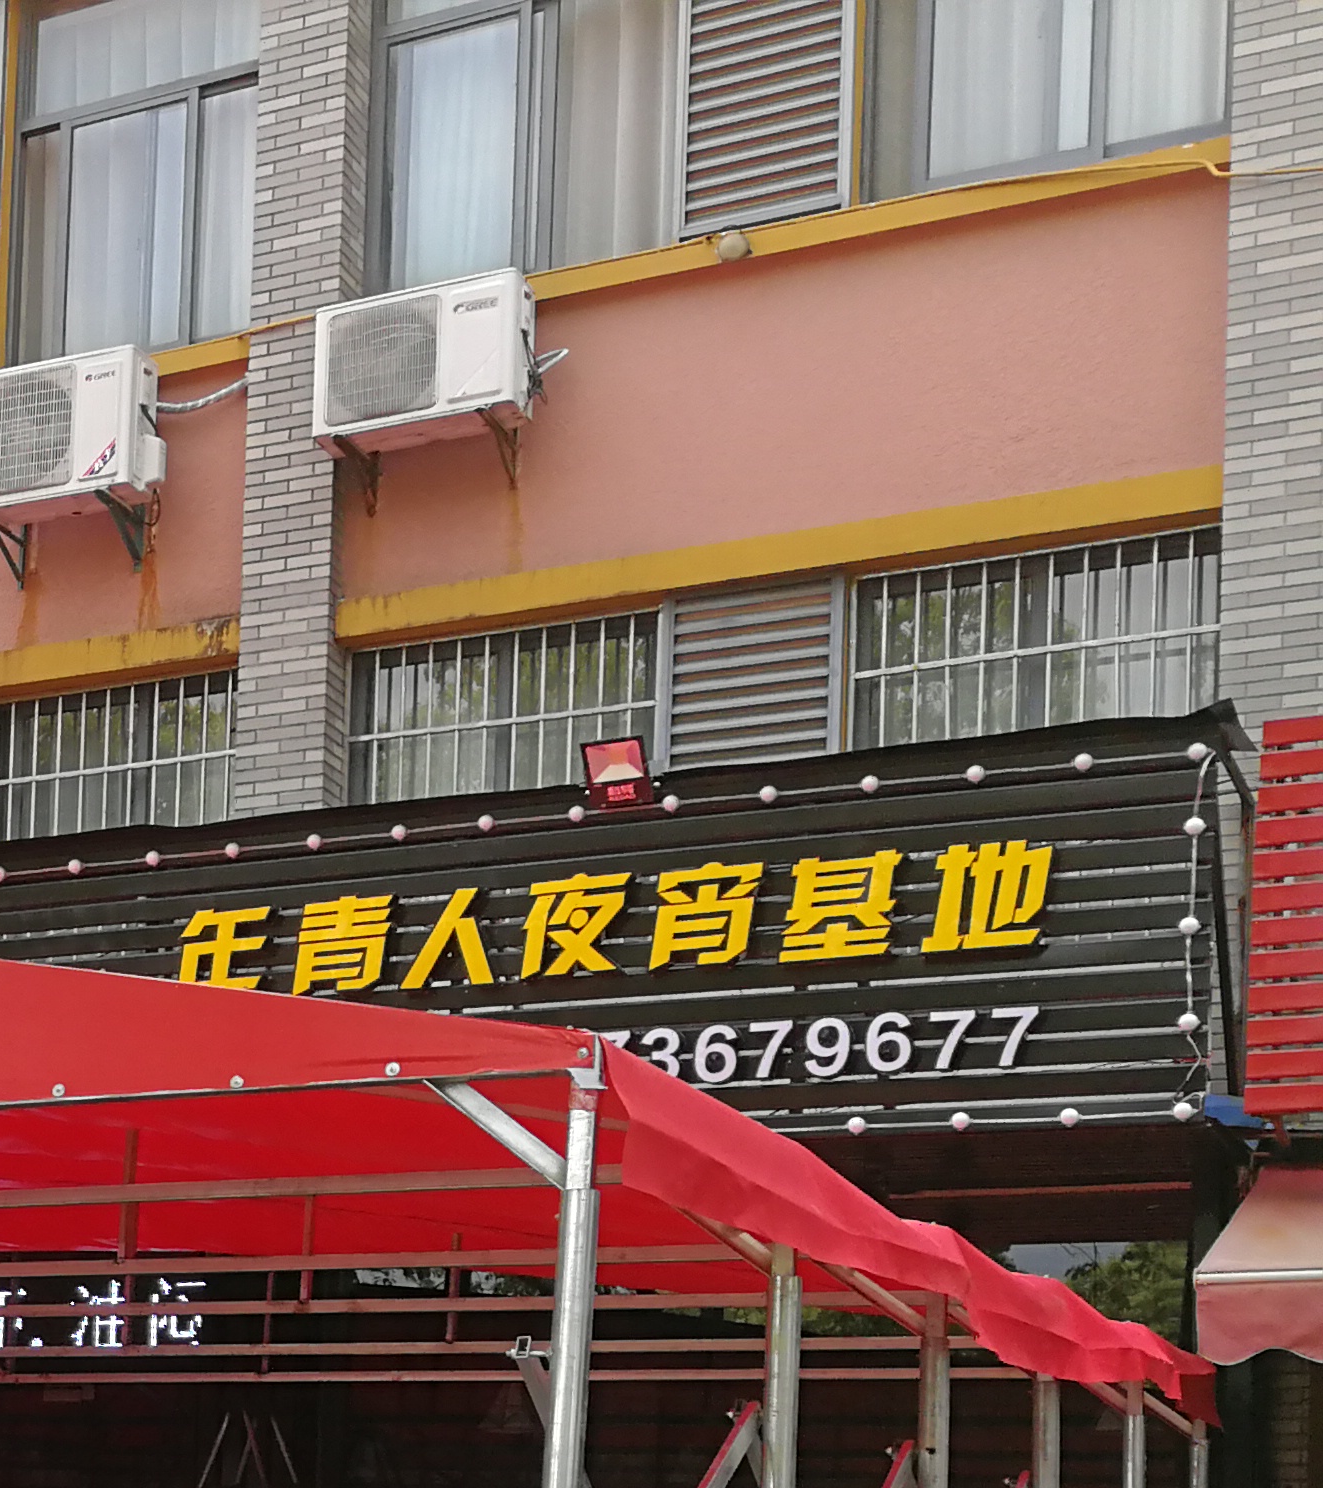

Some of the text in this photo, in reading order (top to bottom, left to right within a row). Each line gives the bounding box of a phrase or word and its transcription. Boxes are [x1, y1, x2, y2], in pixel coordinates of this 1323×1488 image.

[179, 838, 1053, 995] 年青人夜宵基地
